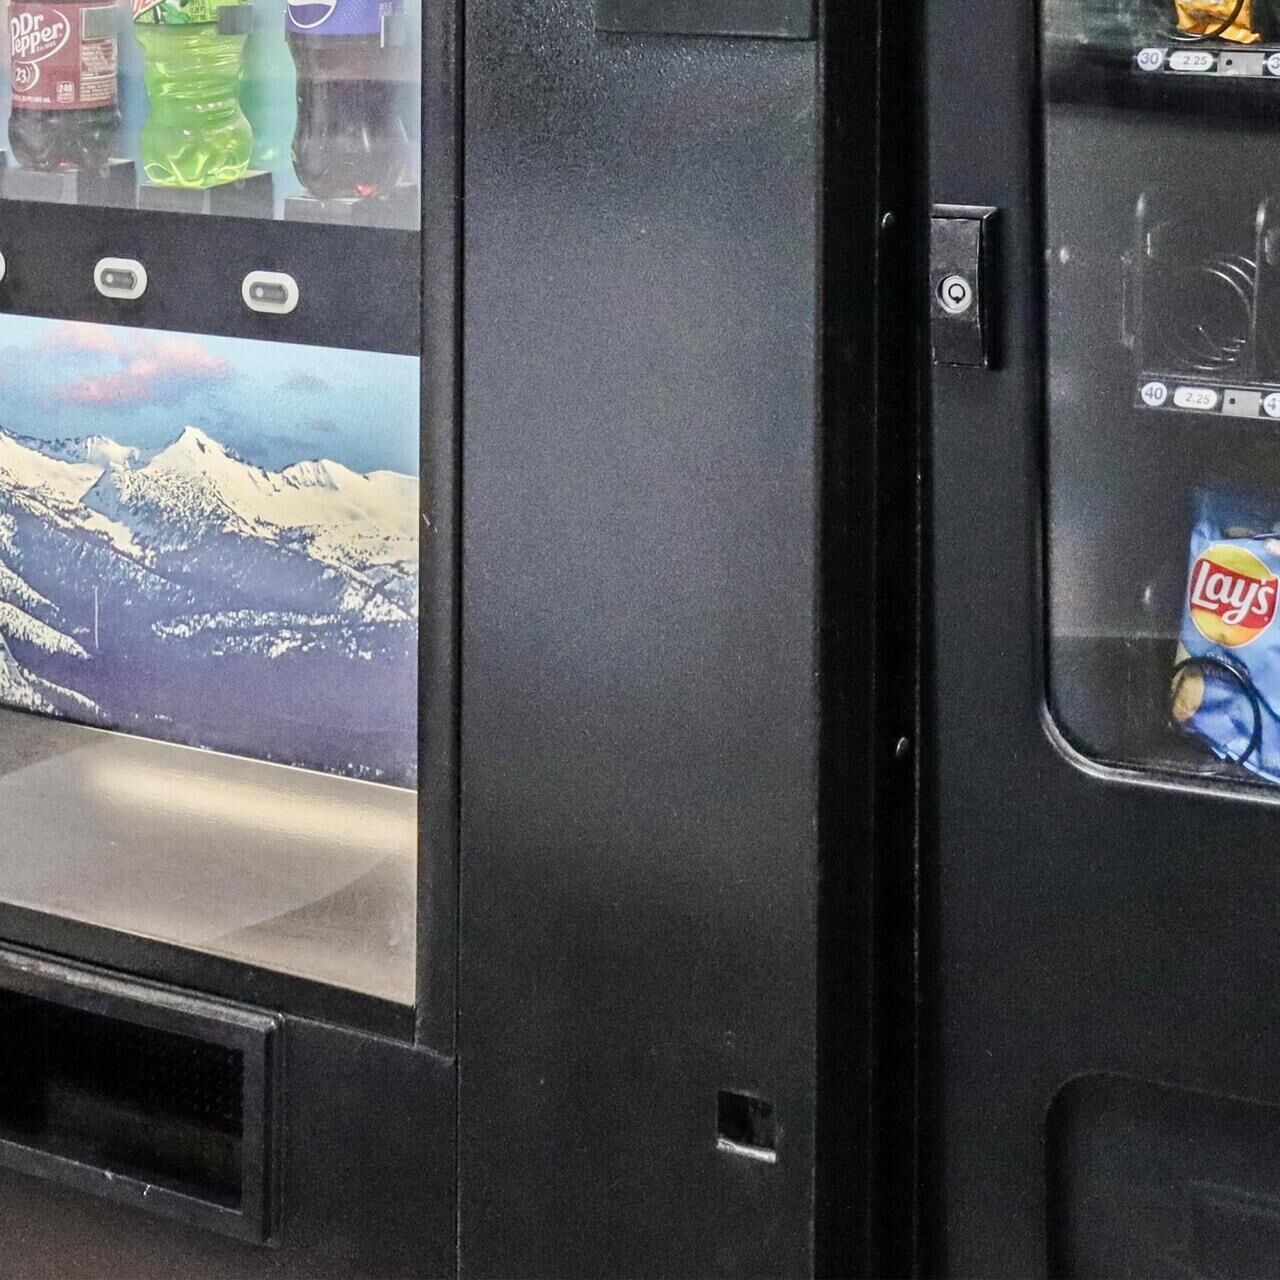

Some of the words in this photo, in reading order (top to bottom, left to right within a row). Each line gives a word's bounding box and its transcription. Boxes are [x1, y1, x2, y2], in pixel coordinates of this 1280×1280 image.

[19, 12, 44, 37] Dr
[1140, 52, 1160, 65] 30
[1183, 56, 1208, 66] 2.25
[1144, 386, 1163, 399] 40
[1186, 392, 1210, 405] 2.25
[1191, 560, 1276, 626] Lay's
